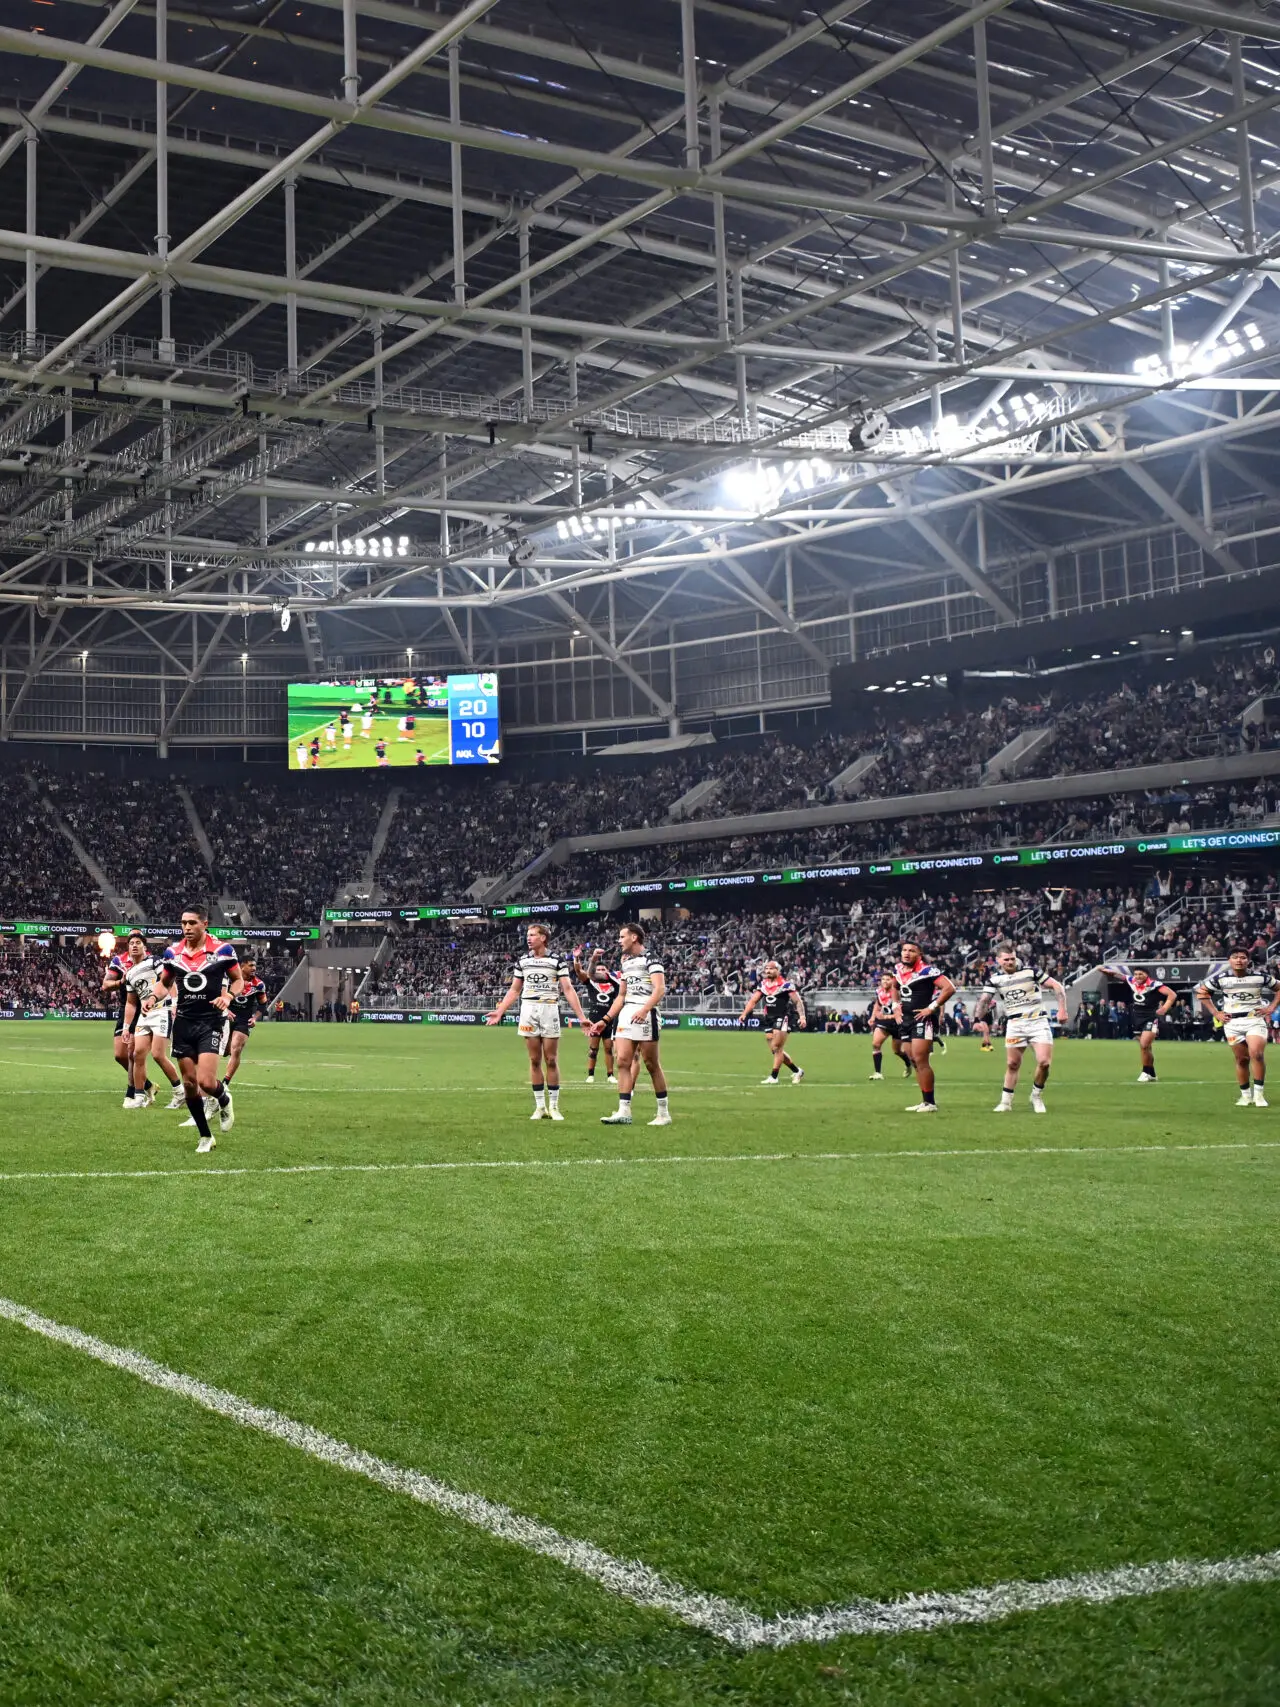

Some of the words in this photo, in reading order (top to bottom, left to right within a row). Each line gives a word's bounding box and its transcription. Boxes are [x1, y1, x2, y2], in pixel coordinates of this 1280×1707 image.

[459, 700, 487, 716] 20
[462, 722, 485, 738] 10
[456, 750, 474, 758] NQL
[1183, 838, 1206, 848] LET'S
[1209, 837, 1227, 846] GET
[1230, 833, 1280, 845] CONNECT
[1031, 851, 1051, 860] LET'S
[1053, 850, 1068, 859] GET
[1070, 845, 1125, 857] CONNECTED
[902, 862, 919, 871] LET'S
[920, 861, 935, 870] GET
[936, 857, 982, 868] CONNECTED
[791, 871, 806, 880] LET'S
[807, 870, 818, 878] GET
[820, 867, 860, 877] CONNECTED
[631, 884, 662, 892] CONNECTED
[694, 879, 706, 887] LET'S
[719, 876, 755, 886] CONNECTED
[688, 1018, 704, 1026] LET'S
[705, 1018, 717, 1026] GET
